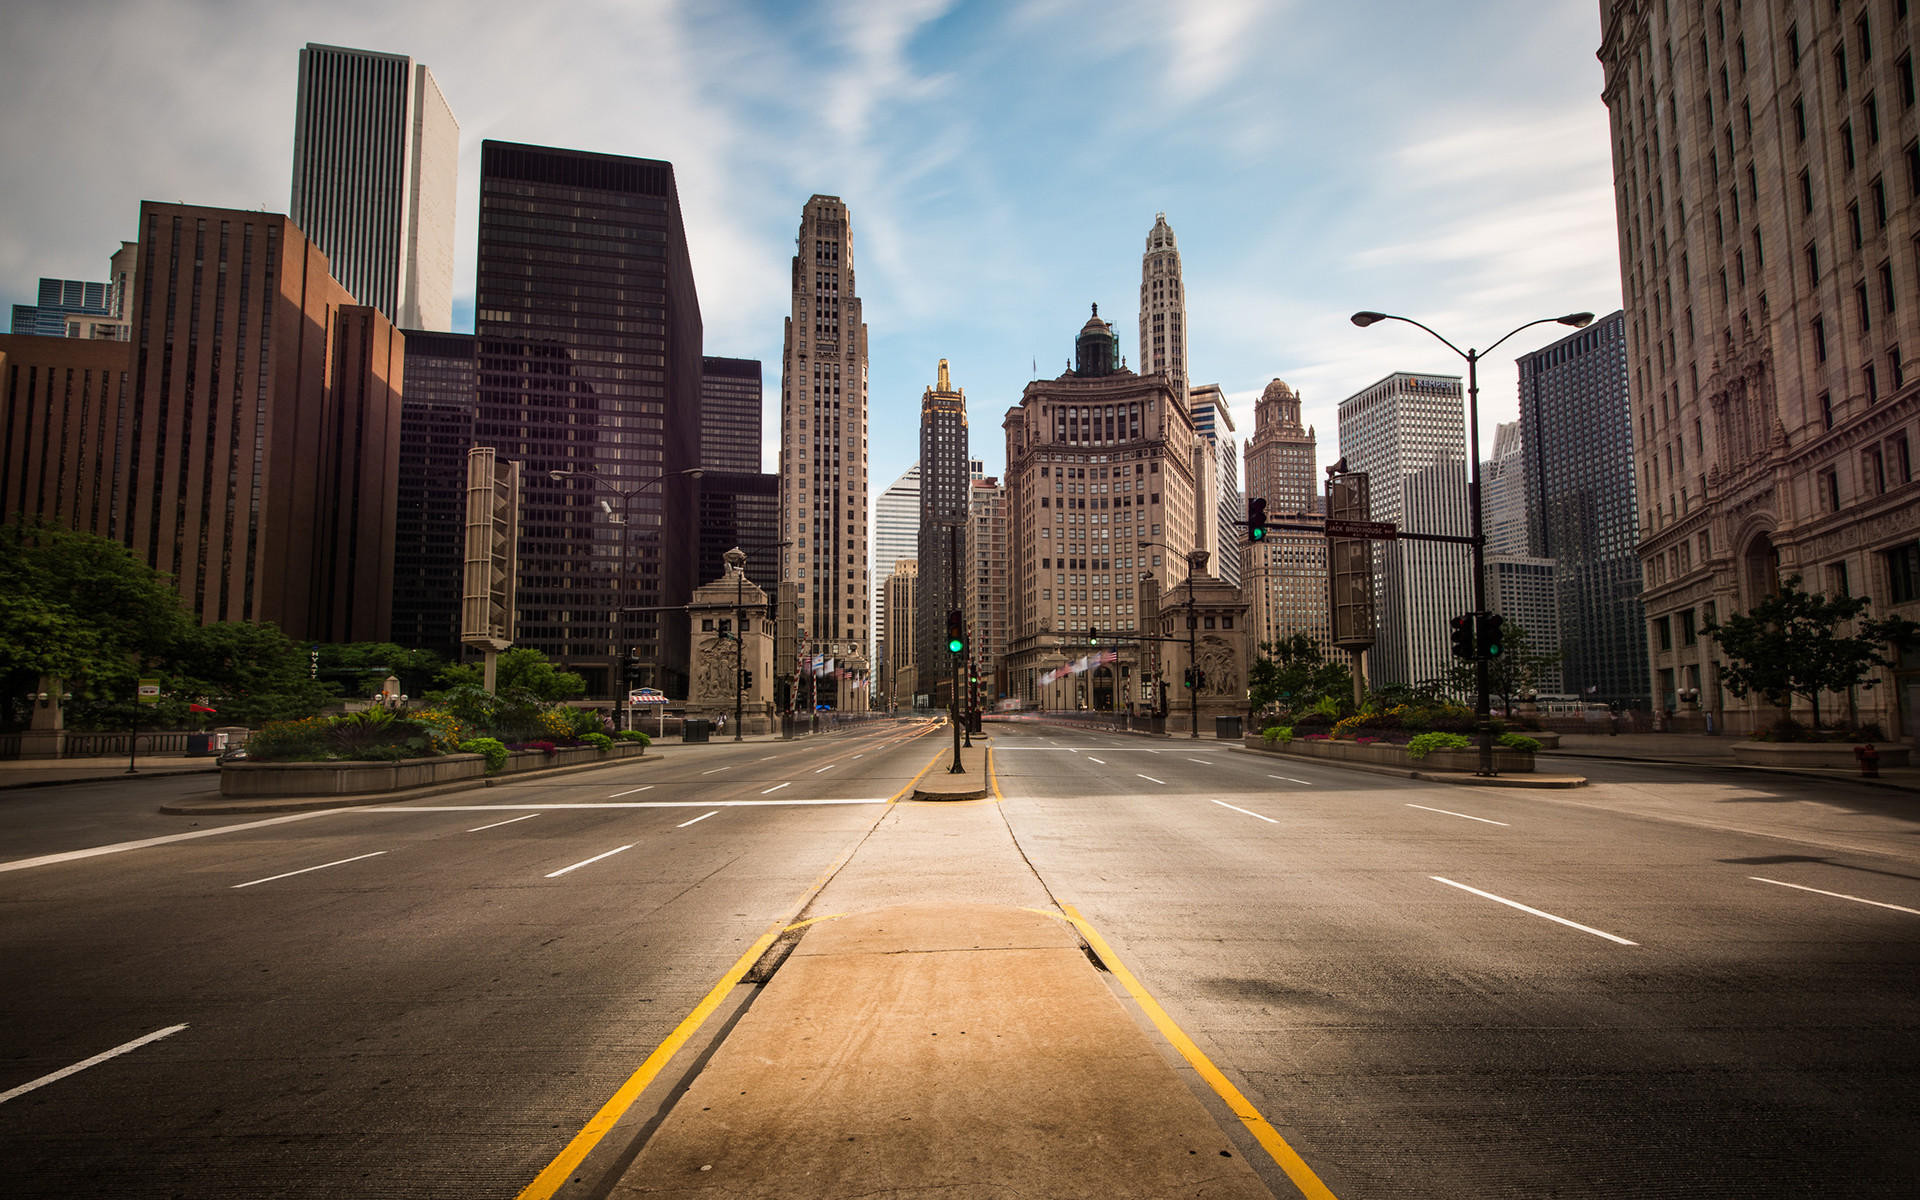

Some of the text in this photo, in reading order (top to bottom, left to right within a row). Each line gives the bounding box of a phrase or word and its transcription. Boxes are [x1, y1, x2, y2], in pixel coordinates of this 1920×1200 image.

[1417, 379, 1451, 388] KEMPER
[1345, 526, 1382, 534] BRICKHOUSE
[310, 651, 319, 679] HYATT
